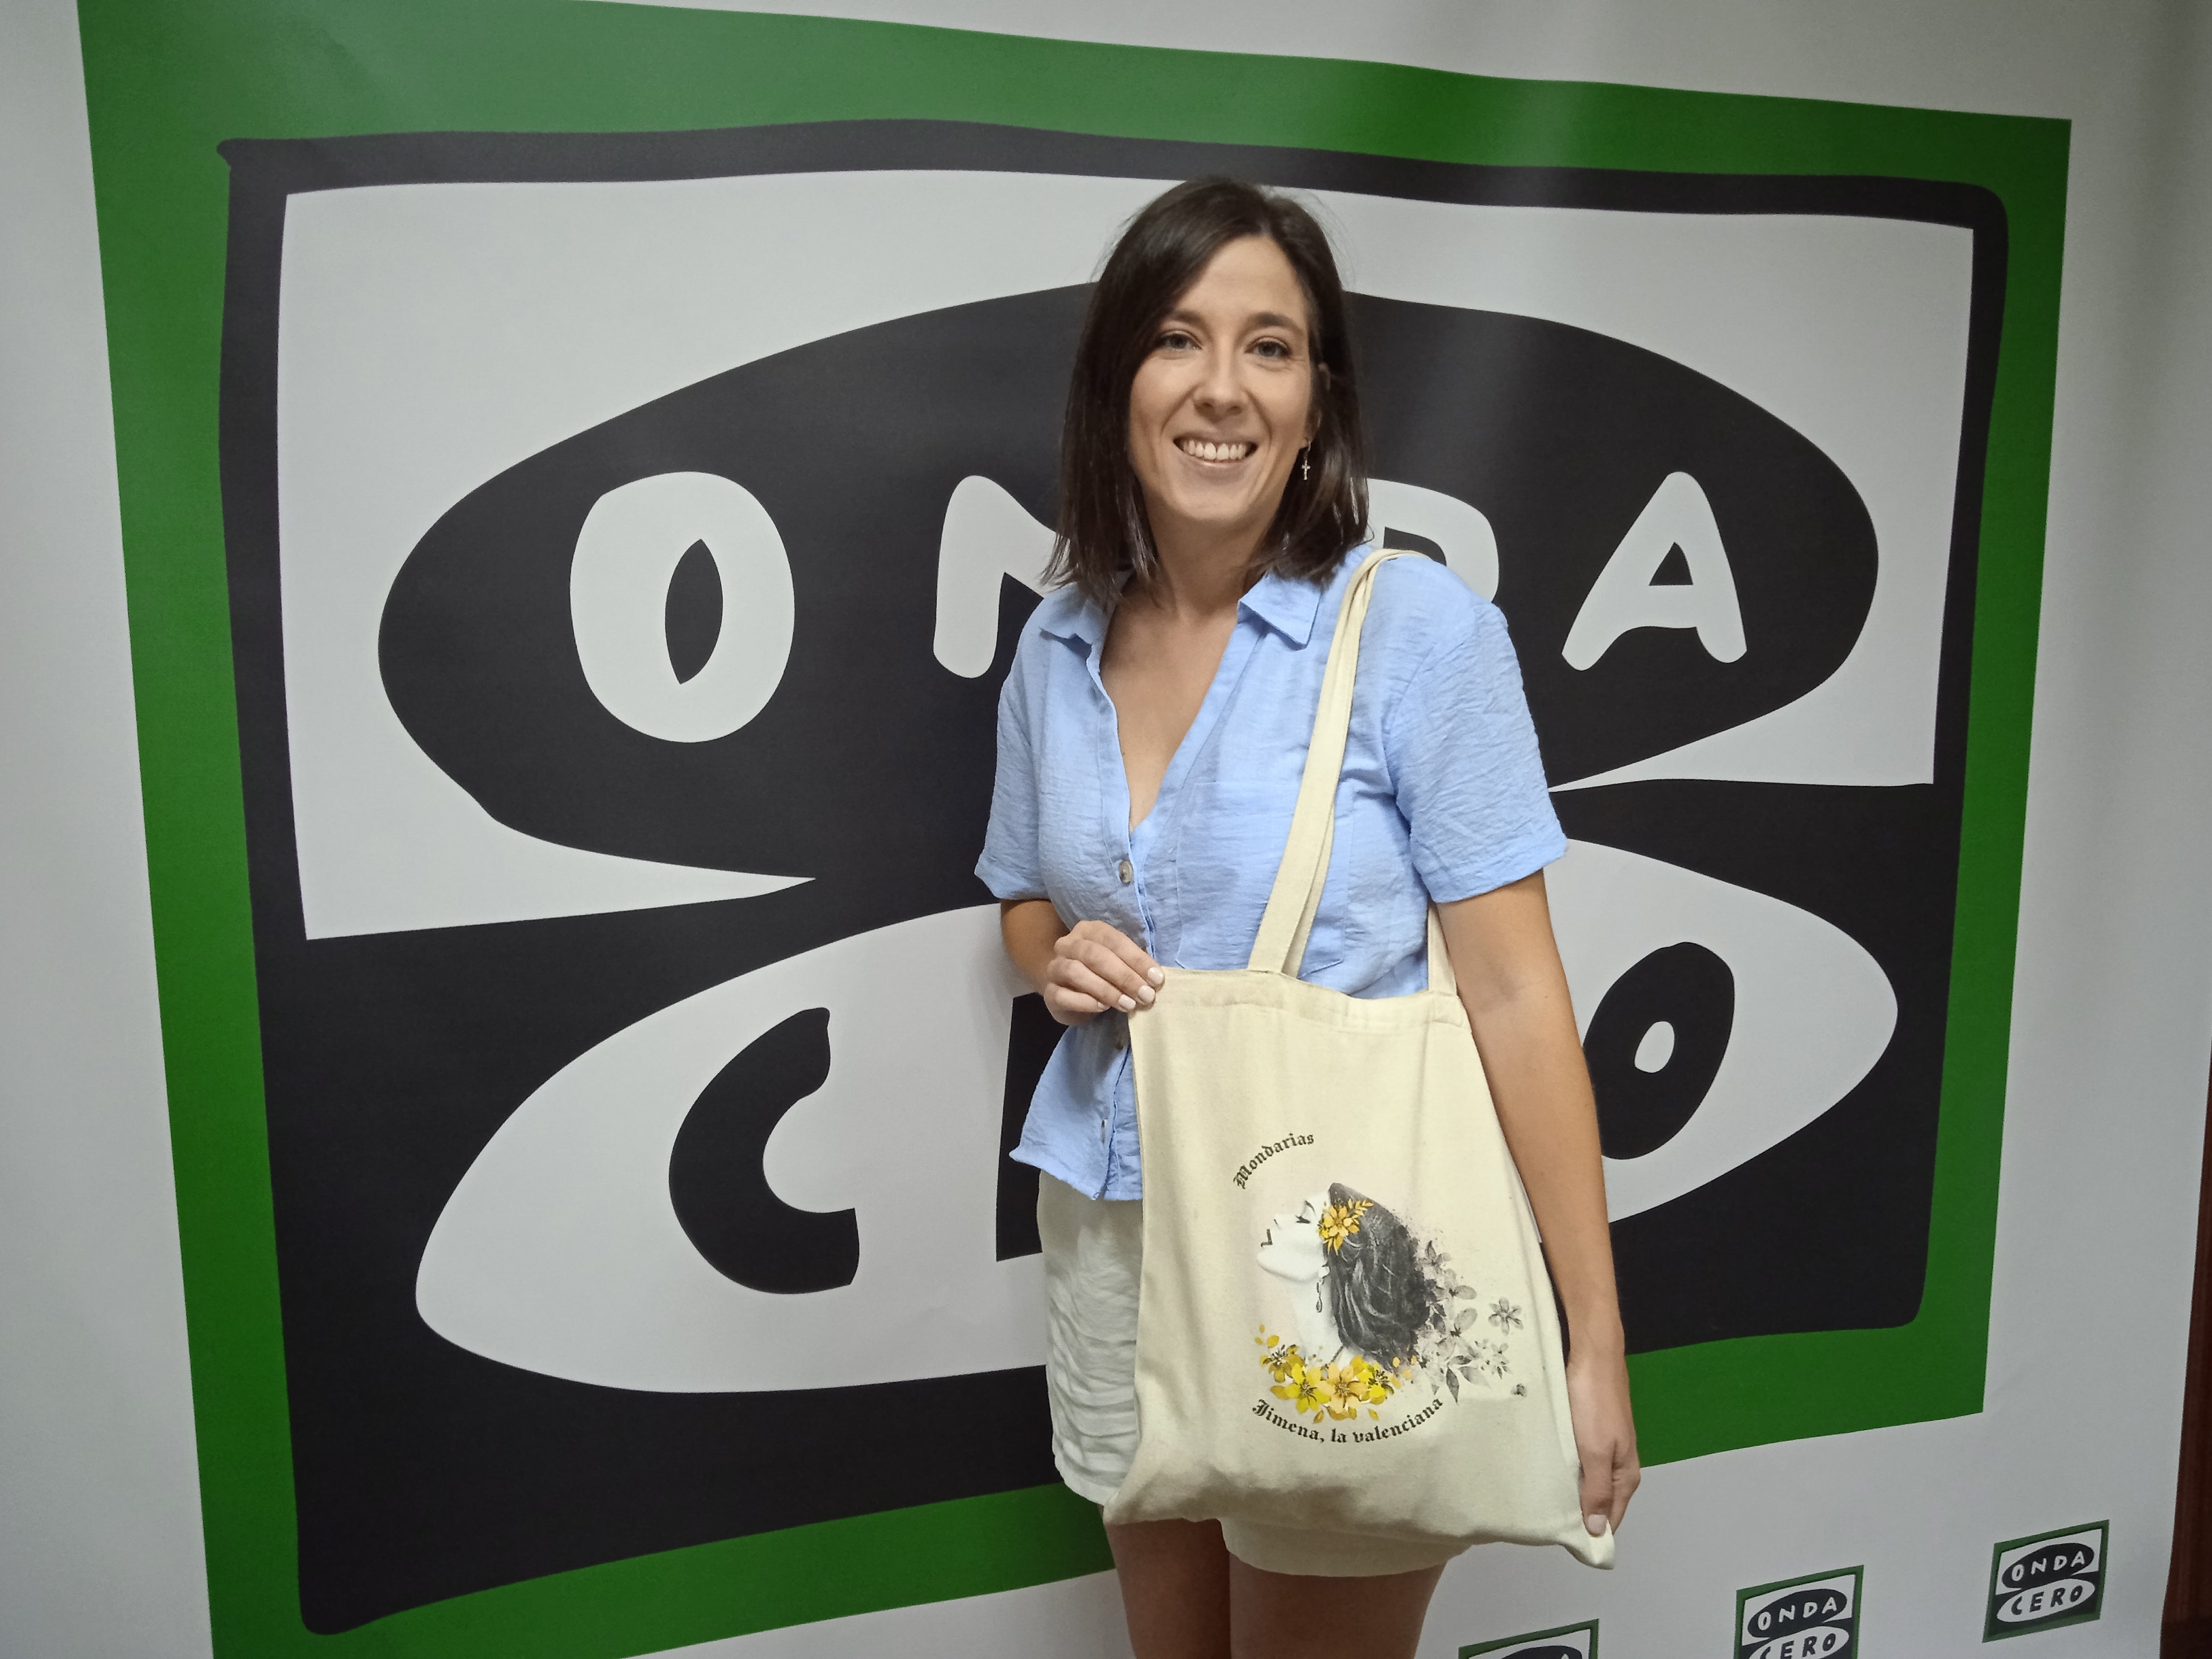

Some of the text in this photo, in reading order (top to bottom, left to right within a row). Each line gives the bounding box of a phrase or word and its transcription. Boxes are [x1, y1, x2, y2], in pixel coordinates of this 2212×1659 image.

[669, 942, 1735, 1294] CO
[1233, 1133, 1314, 1189] Mondarias
[1252, 1398, 1443, 1443] Jimena, la valenciana
[2011, 1551, 2085, 1582] ONDA
[1757, 1596, 1837, 1631] ONDA
[2011, 1585, 2083, 1615] CERO
